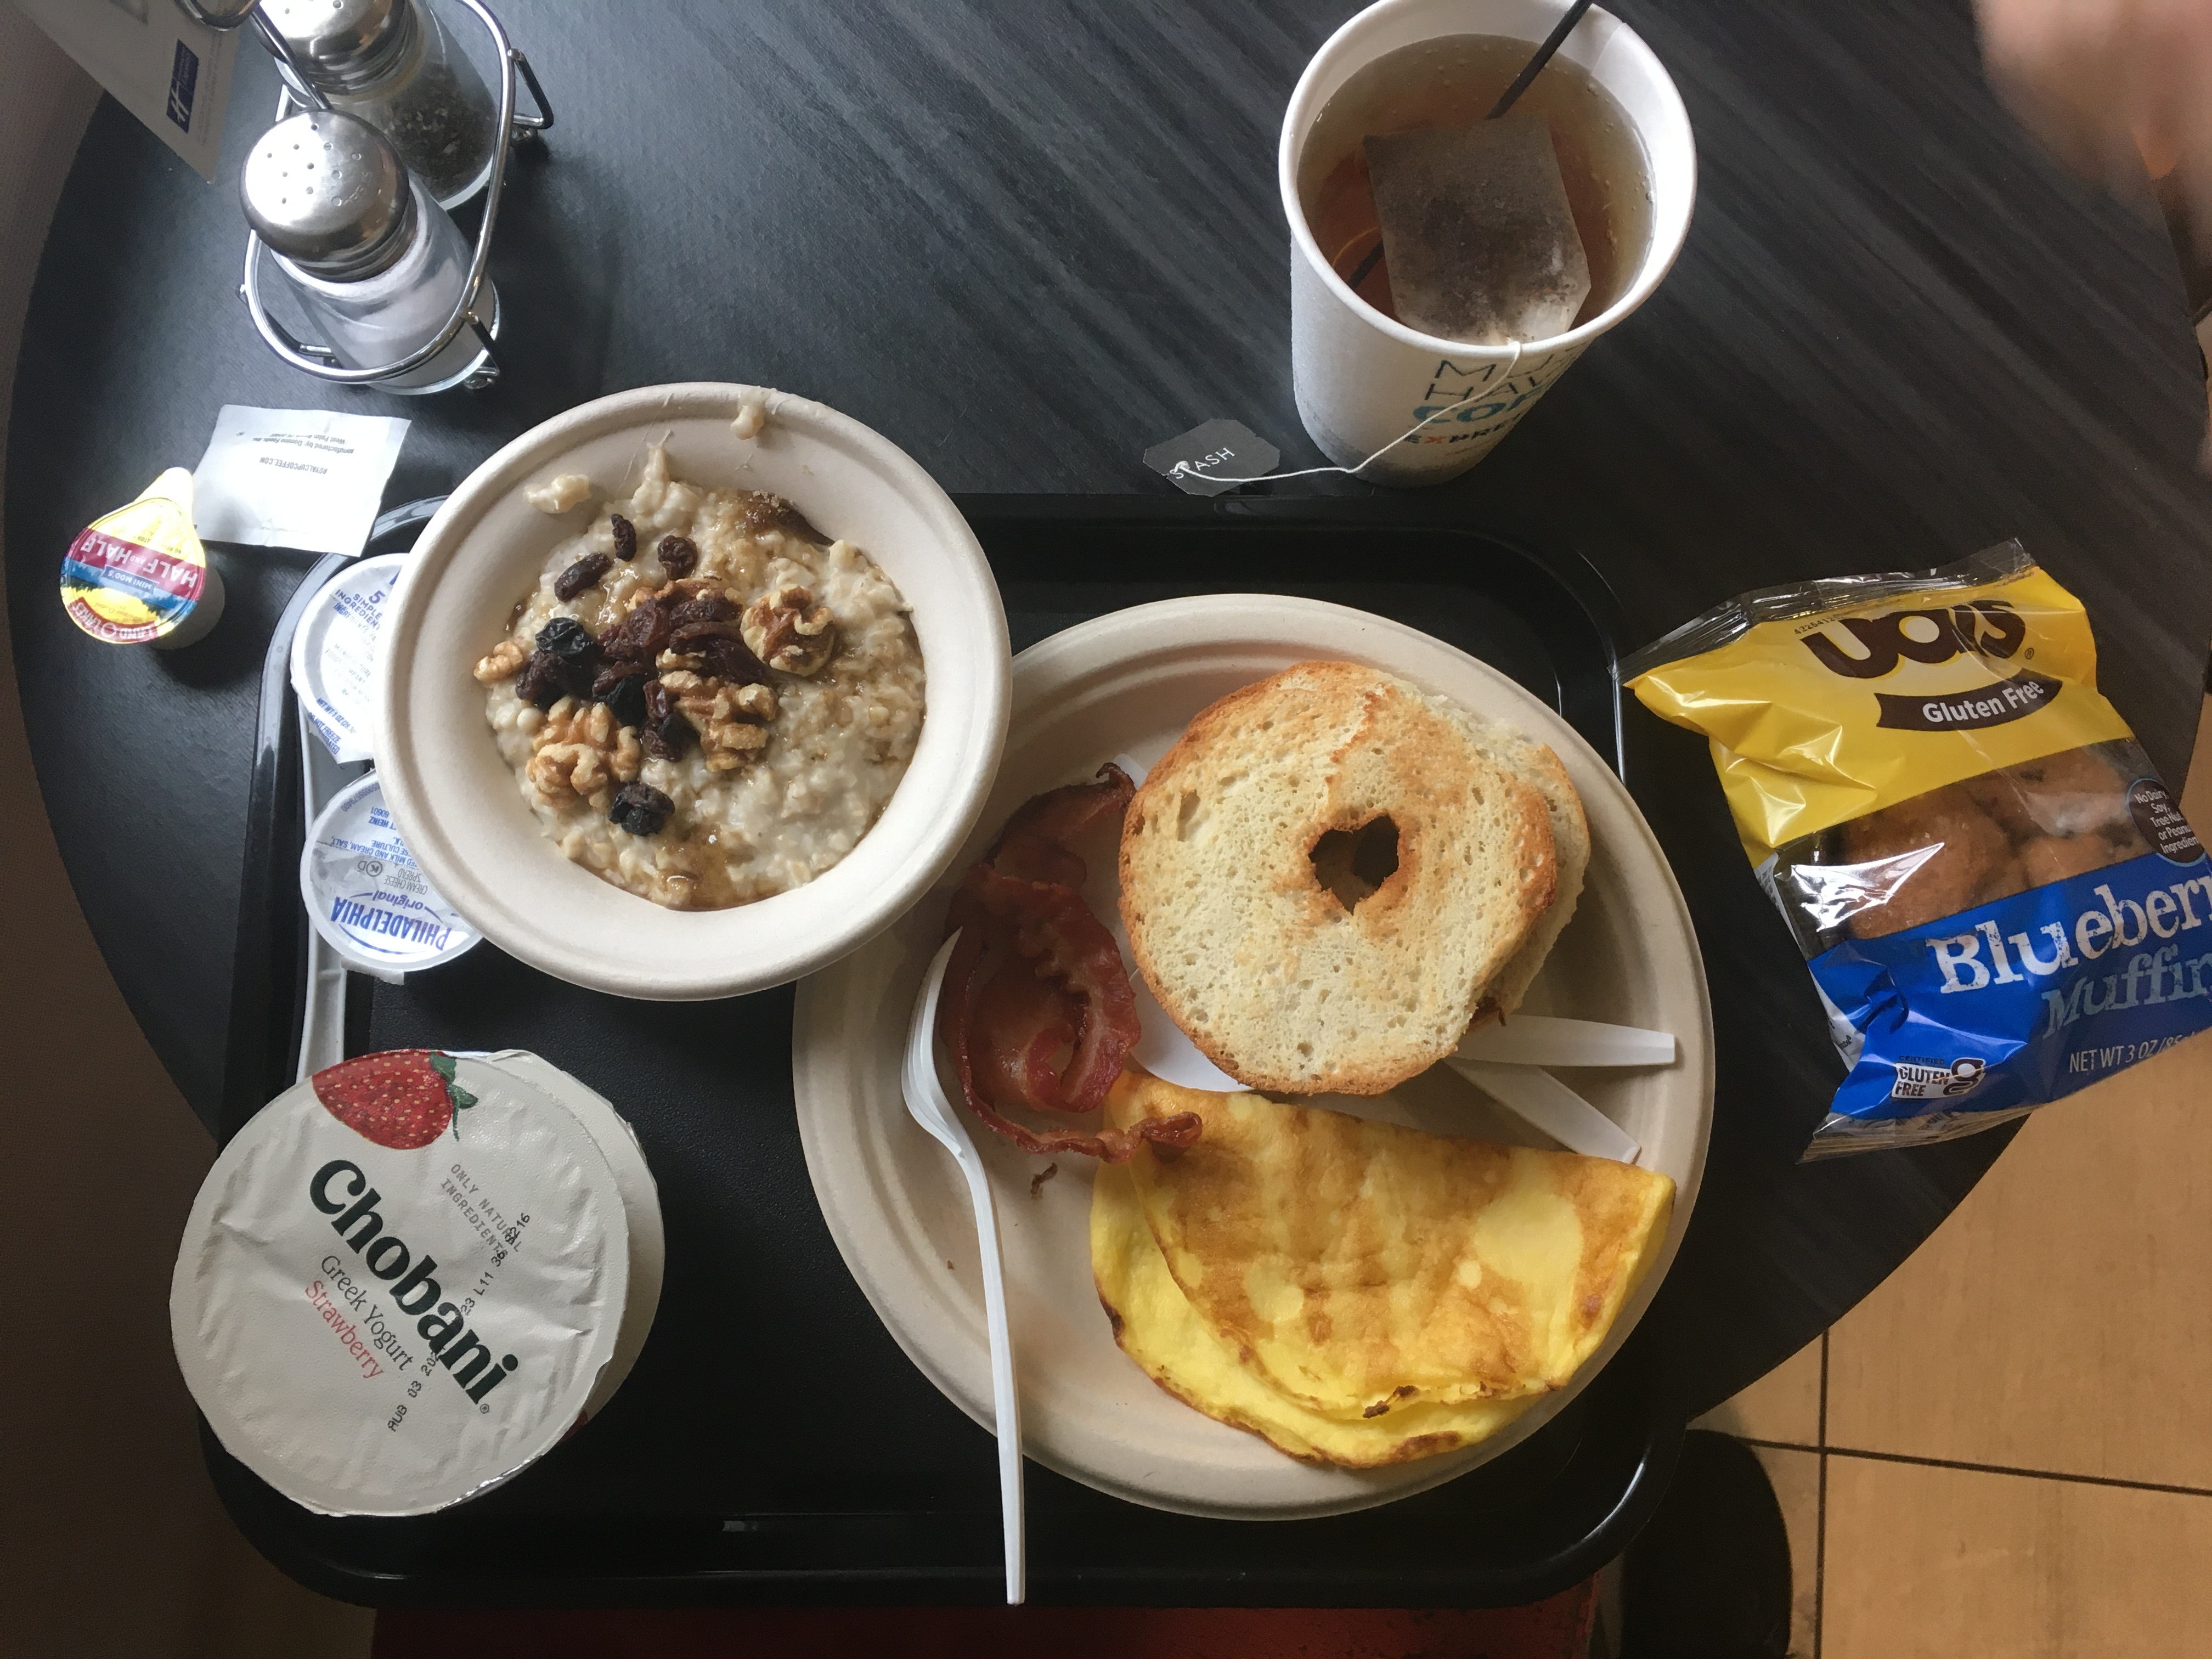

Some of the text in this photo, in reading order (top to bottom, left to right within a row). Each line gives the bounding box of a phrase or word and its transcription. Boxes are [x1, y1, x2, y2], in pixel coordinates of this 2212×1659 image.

[259, 456, 328, 475] ROYALCUPCOFFEE.COM
[1169, 447, 1235, 479] SASH
[80, 537, 199, 588] HALF AND HALF
[107, 568, 153, 591] MINI MOO'S
[353, 593, 383, 620] SIMPLE
[368, 590, 386, 604] 5
[72, 601, 104, 629] LAKES
[119, 624, 154, 639] LAND
[315, 697, 328, 708] NET
[324, 706, 335, 716] WT
[1922, 679, 2045, 723] Gluten Free
[321, 725, 342, 745] FREEZE
[2134, 793, 2149, 804] No
[370, 806, 390, 817] 60601
[2150, 803, 2171, 814] Soy,
[368, 816, 390, 828] HEINZ
[2149, 816, 2170, 828] Tree
[331, 836, 349, 848] SALT,
[2158, 825, 2192, 840] or Peanu
[349, 840, 374, 855] CREAM,
[374, 849, 389, 860] AND
[2159, 836, 2199, 854] Ingredien
[390, 853, 407, 864] MILK
[383, 874, 428, 895] CREAM CHEESE
[397, 868, 422, 883] SPREAD
[371, 890, 424, 910] original
[330, 896, 452, 951] PHILADELPHIA
[1926, 875, 2212, 994] Blueberr
[1898, 1055, 1946, 1065] CERTIFIED
[2069, 1049, 2097, 1073] NET
[2100, 1045, 2125, 1068] WT
[2125, 1044, 2136, 1063] 3
[2137, 1039, 2158, 1059] OZ
[1899, 1066, 1951, 1085] GLUTEN
[1894, 1081, 1927, 1097] FREE
[450, 1164, 479, 1194] ONLY
[309, 1159, 518, 1406] Chobani
[321, 1255, 415, 1371] Greek Yogurt
[304, 1280, 384, 1379] Strawberry
[407, 1380, 422, 1398] 03
